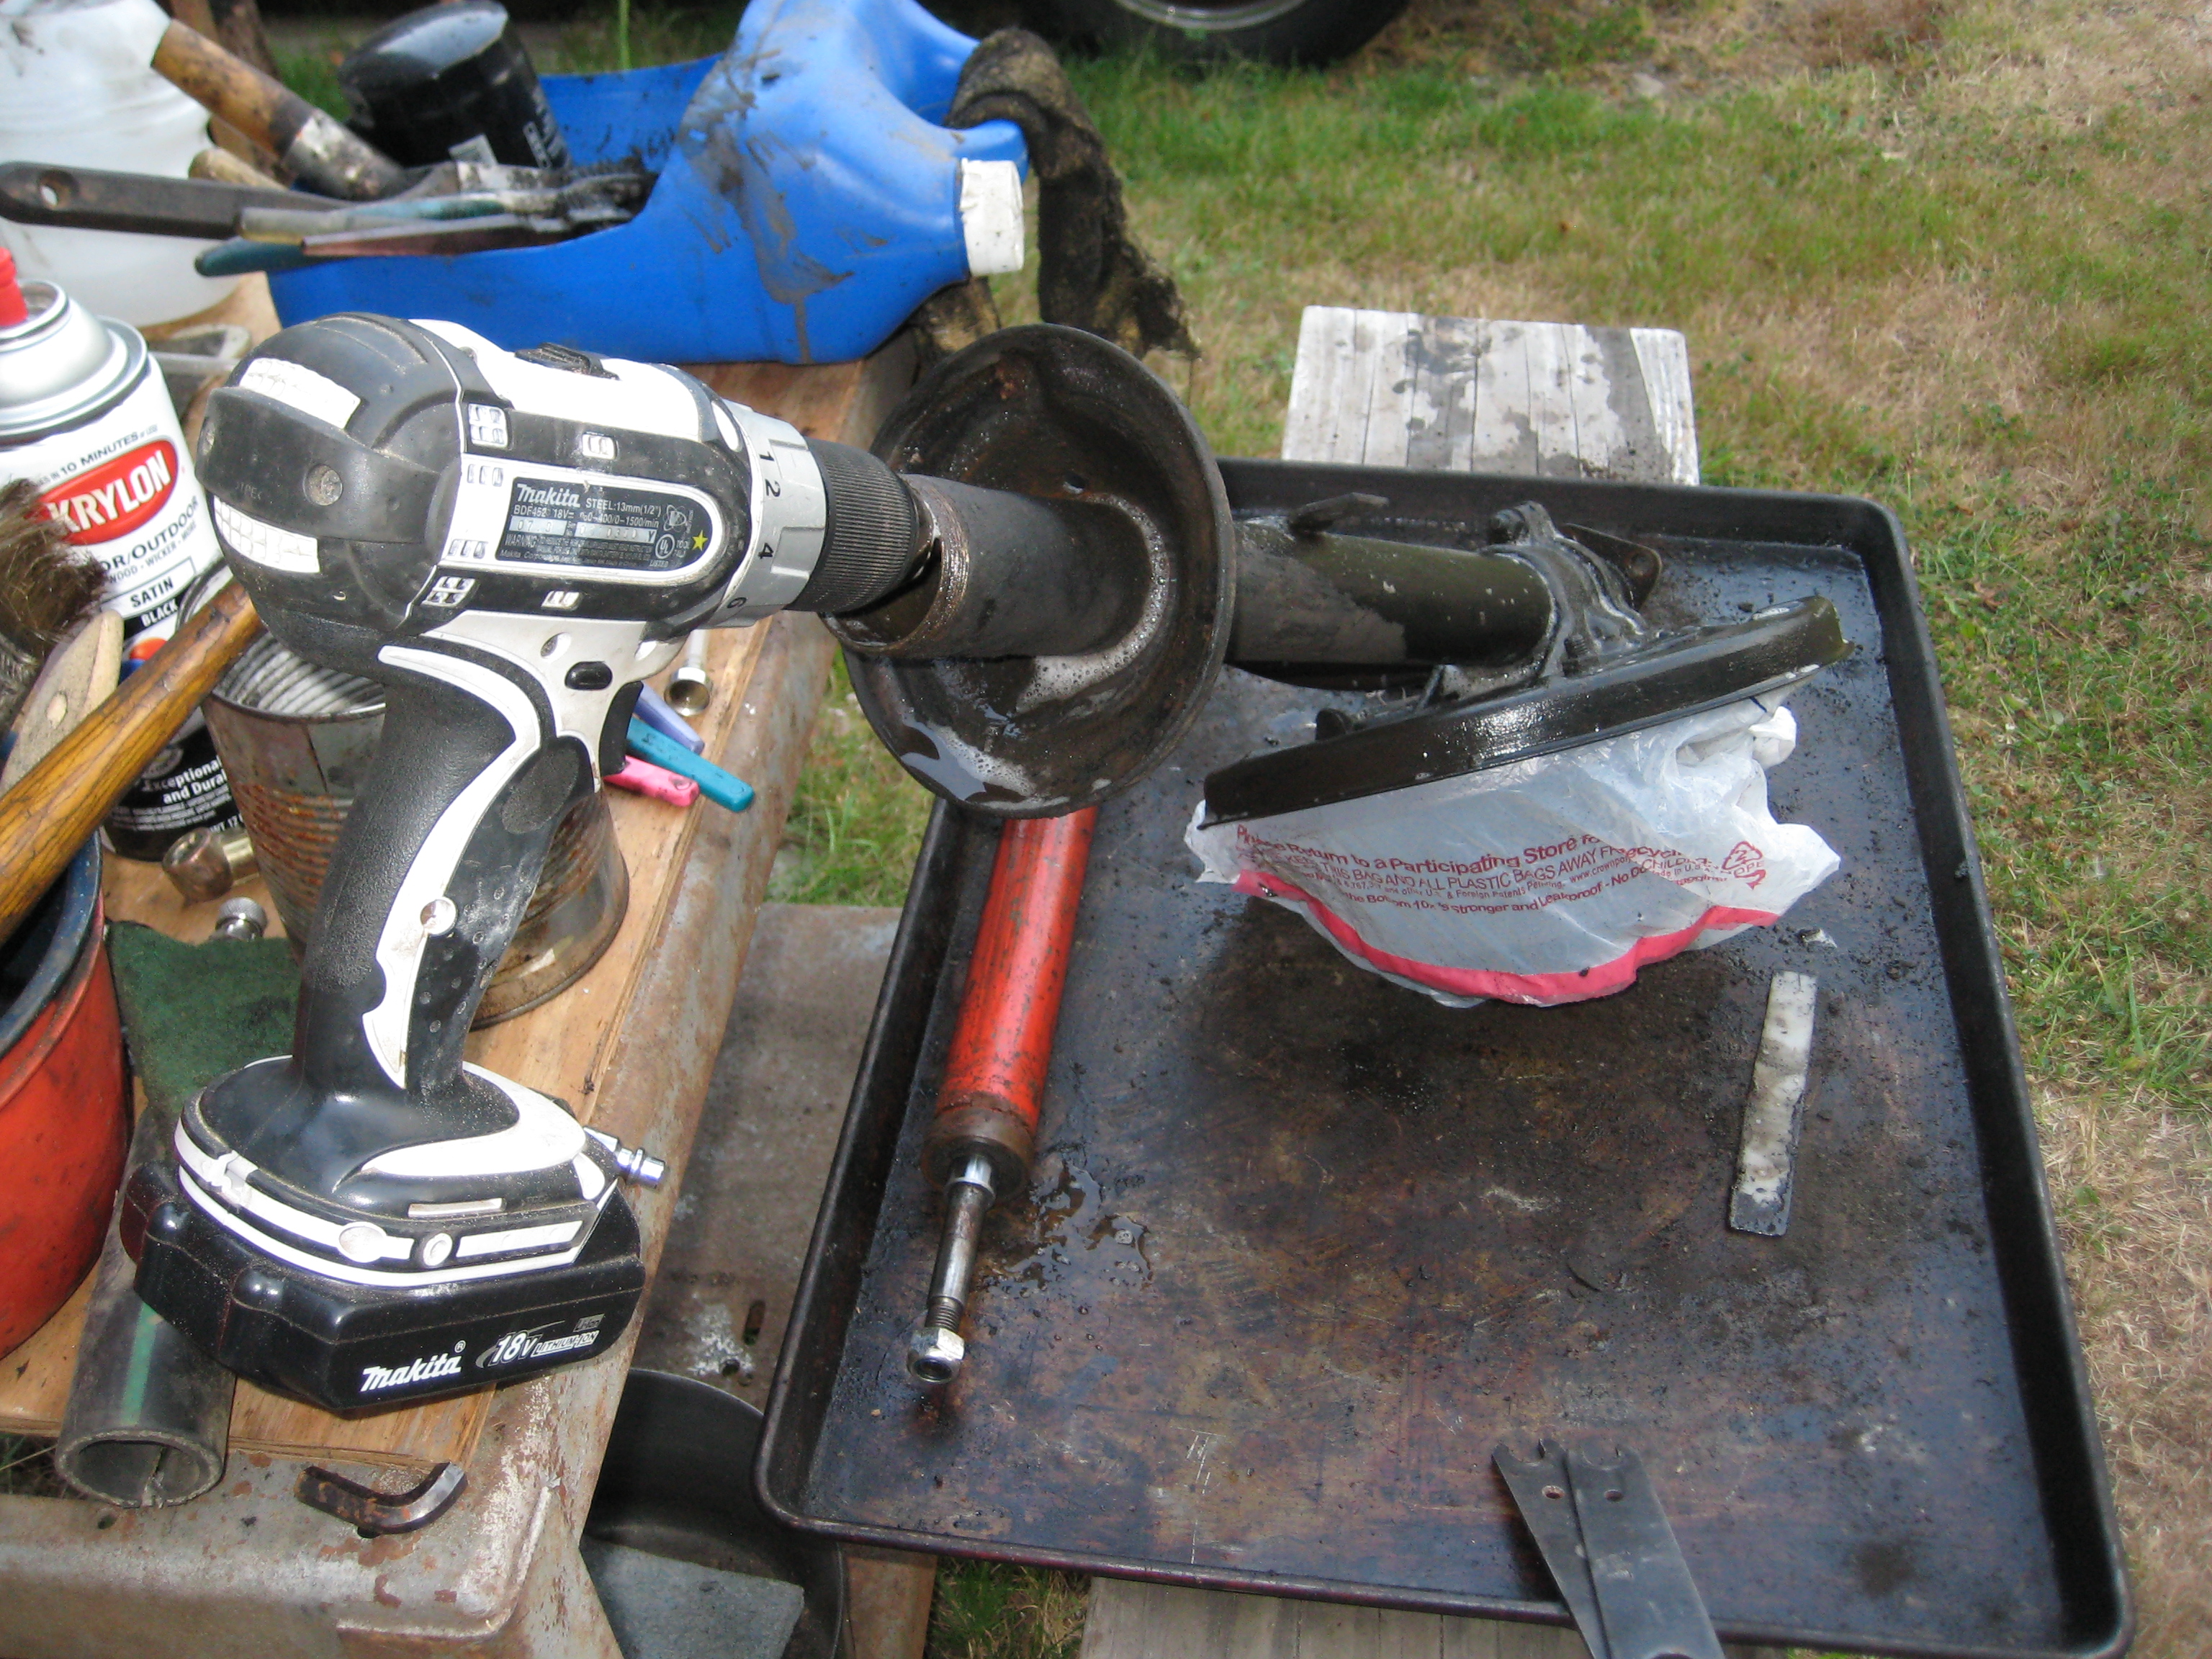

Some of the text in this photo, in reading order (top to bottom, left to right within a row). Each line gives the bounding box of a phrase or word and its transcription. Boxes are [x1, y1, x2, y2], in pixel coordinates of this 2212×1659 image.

[60, 462, 77, 475] 10
[80, 431, 138, 467] MINUTES
[759, 451, 775, 462] 1
[45, 449, 172, 534] KRYLON
[765, 478, 781, 498] 2
[145, 541, 177, 567] WICKER
[758, 542, 774, 559] 4
[130, 576, 175, 608] SATIN
[140, 598, 179, 627] BLACK
[163, 785, 190, 804] and
[1320, 862, 1351, 880] THIS
[1352, 868, 1383, 884] BAG
[1385, 873, 1416, 888] AND
[1419, 878, 1446, 891] ALL
[1447, 872, 1511, 889] PLASTIC
[1513, 865, 1556, 884] BAGS
[1557, 848, 1597, 876] AWAY
[1351, 853, 1370, 868] to
[1373, 858, 1388, 869] a
[1388, 853, 1521, 876] Participating
[1523, 837, 1577, 864] Store
[1451, 904, 1509, 914] stronger
[1511, 899, 1538, 912] and
[1537, 881, 1603, 907] Leakproof
[1611, 872, 1629, 886] No
[1455, 889, 1489, 899] Foreign
[1492, 886, 1526, 898] Patents
[530, 1330, 601, 1358] LITHIUM-ION
